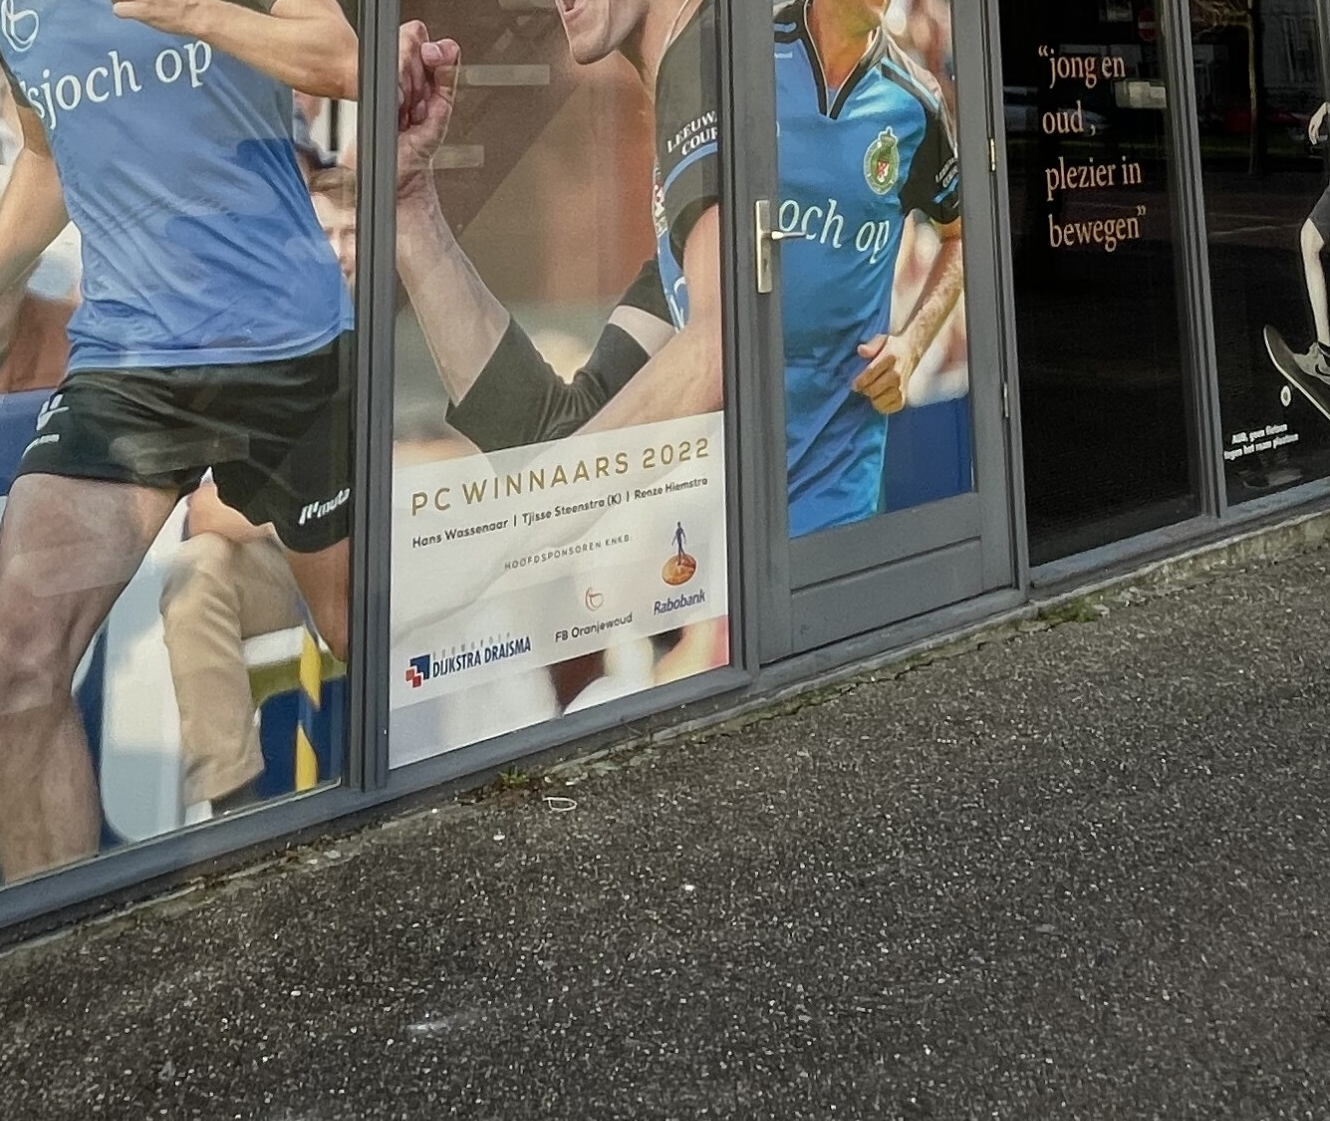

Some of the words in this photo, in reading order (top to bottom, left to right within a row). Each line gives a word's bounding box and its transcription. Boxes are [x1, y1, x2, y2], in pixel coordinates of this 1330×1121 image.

[155, 40, 212, 89] op
[1102, 53, 1126, 79] en
[1045, 155, 1117, 202] plezier
[1121, 159, 1142, 185] in
[855, 220, 890, 265] op
[412, 487, 452, 516] PC
[462, 452, 629, 505] WINNAARS
[642, 437, 709, 469] 2022
[412, 534, 442, 549] Hans
[444, 519, 509, 540] Wassenaar
[554, 500, 605, 518] Steenstra
[607, 492, 622, 507] (K)
[665, 478, 708, 493] Hiemstra
[653, 588, 706, 616] Rabobank
[555, 629, 569, 643] FB
[571, 612, 633, 638] Oranjewoud
[432, 649, 482, 678] DIJKSTRA
[484, 636, 531, 664] DRAISMA
